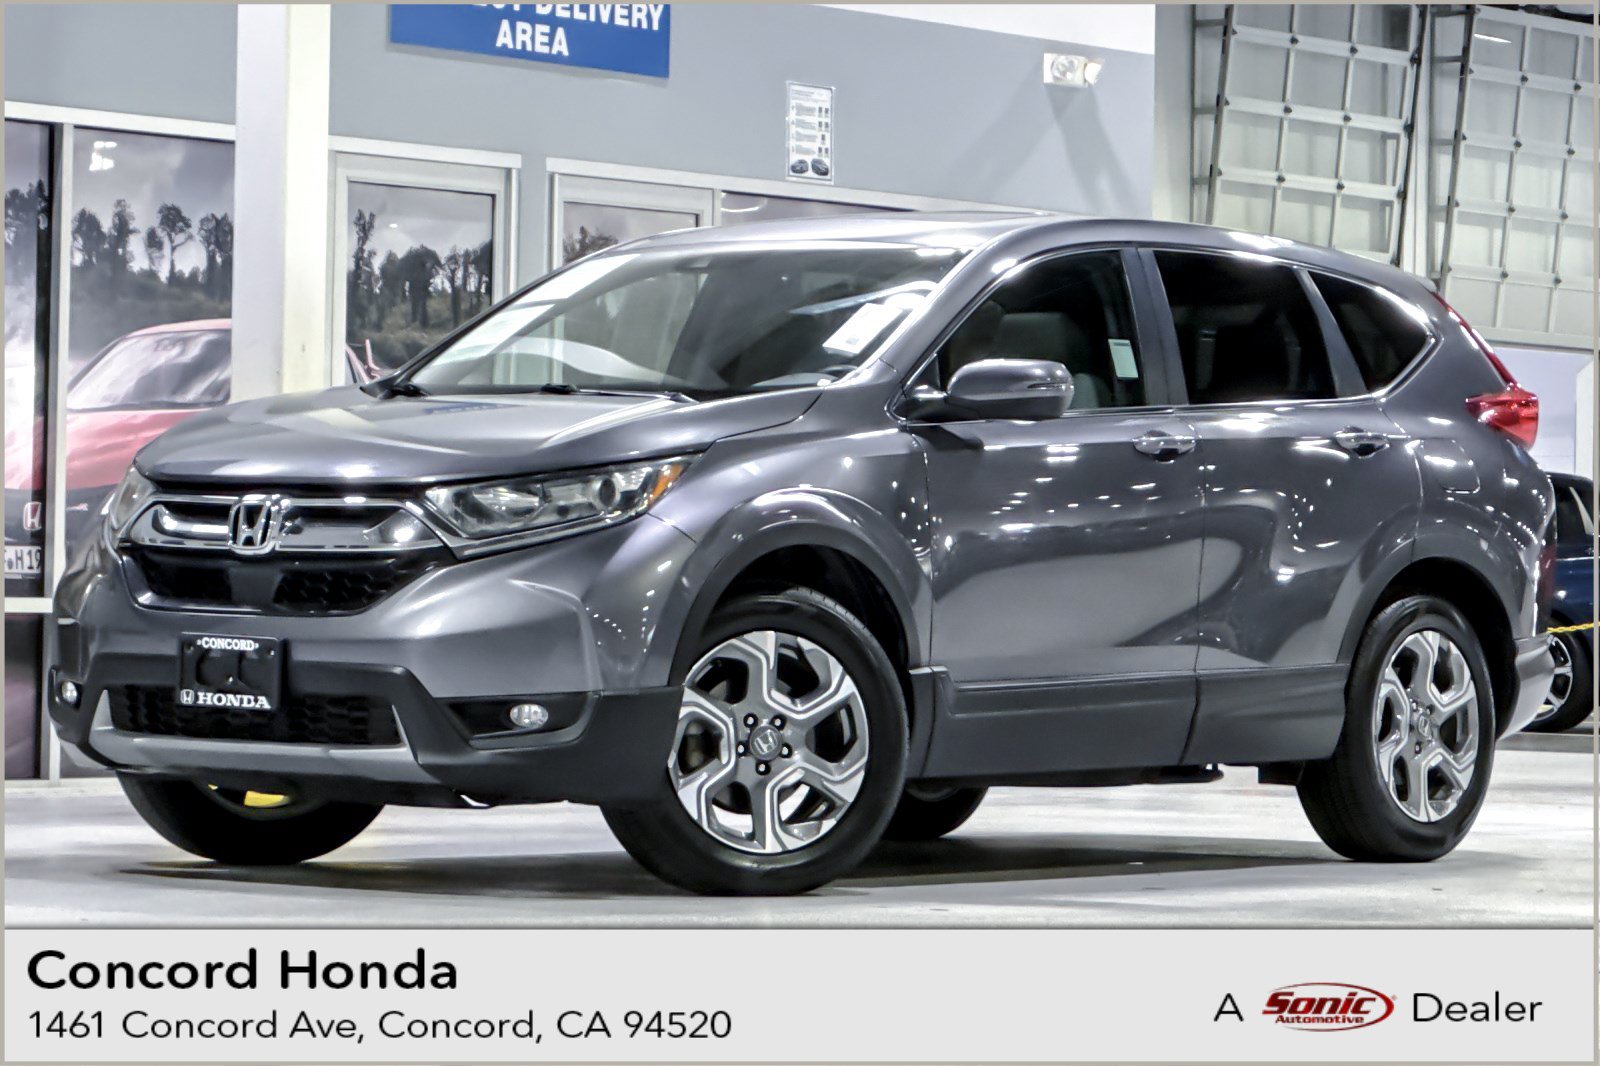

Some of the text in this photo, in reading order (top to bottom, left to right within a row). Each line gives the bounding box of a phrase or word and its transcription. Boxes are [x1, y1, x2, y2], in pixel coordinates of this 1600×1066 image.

[496, 19, 569, 56] AREA
[202, 637, 255, 651] CONCORD
[196, 691, 272, 709] HONDA
